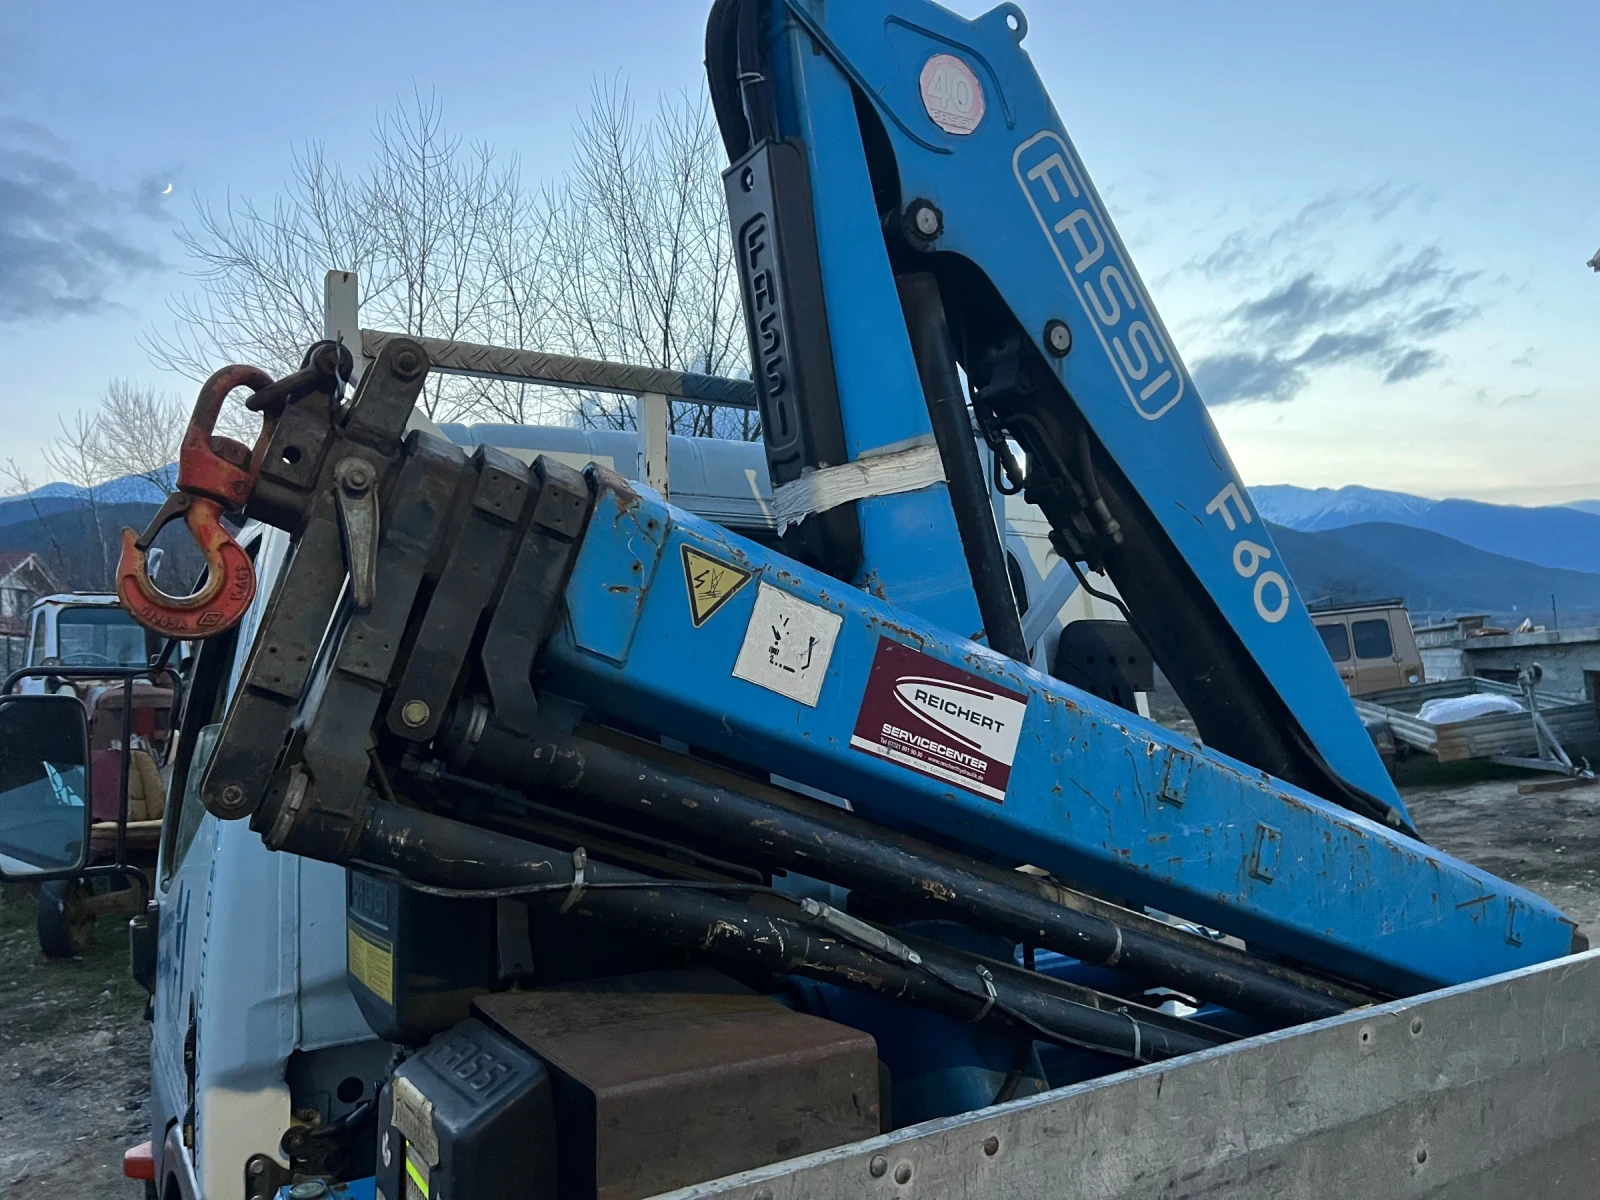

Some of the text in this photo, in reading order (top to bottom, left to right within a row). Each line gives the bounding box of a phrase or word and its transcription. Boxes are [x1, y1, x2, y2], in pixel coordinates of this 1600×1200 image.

[926, 67, 974, 115] 40
[1027, 152, 1172, 401] FASSI
[747, 222, 788, 437] FASSI
[914, 689, 1005, 733] REICHERT
[881, 723, 988, 771] SERVICECENTER
